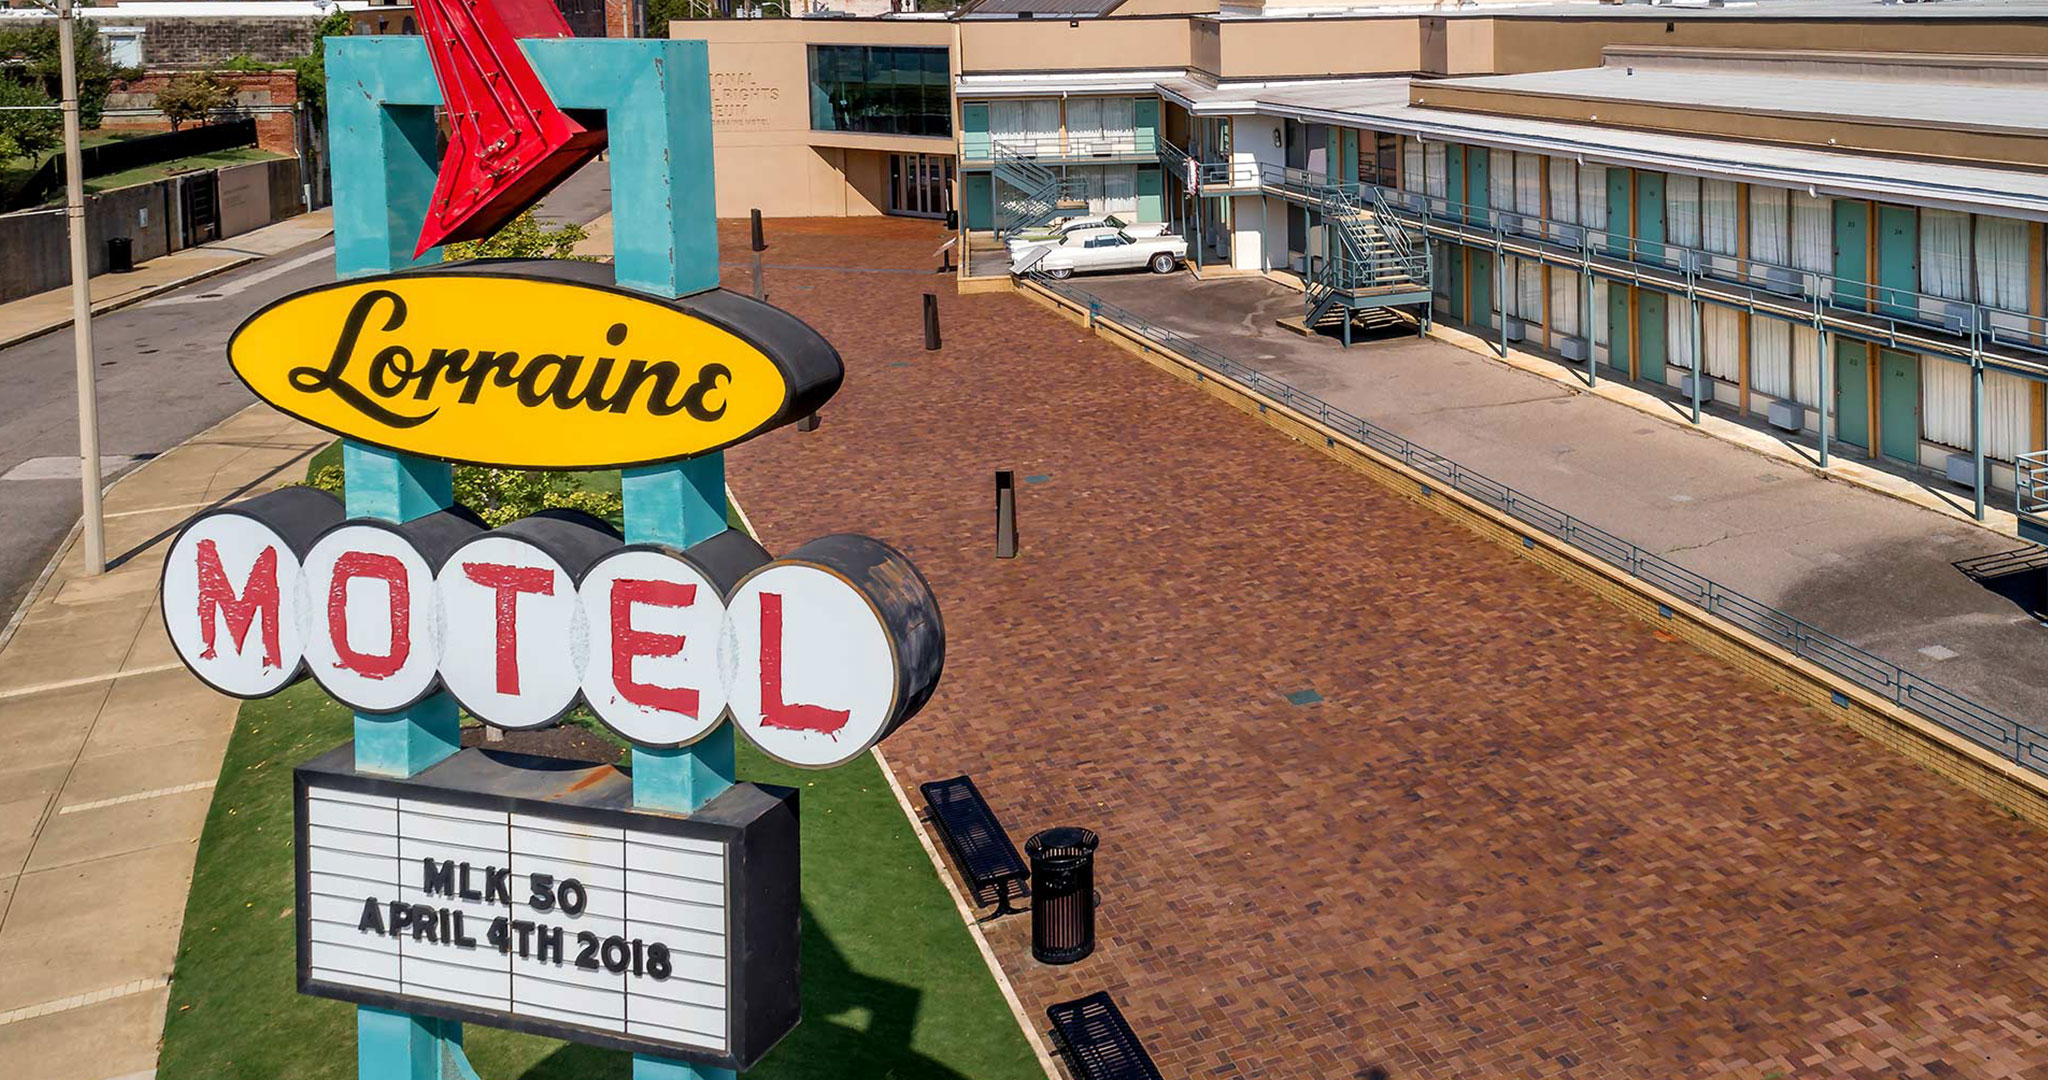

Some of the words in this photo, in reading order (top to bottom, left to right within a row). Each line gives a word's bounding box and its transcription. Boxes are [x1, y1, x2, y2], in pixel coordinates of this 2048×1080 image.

[709, 72, 755, 86] IONAL
[288, 290, 732, 429] Lorraine
[197, 539, 851, 738] MOTEL
[423, 857, 511, 906] MLK
[529, 873, 588, 917] 50
[358, 896, 477, 948] APRIL
[486, 915, 564, 966] 4TH
[574, 930, 673, 981] 2018
